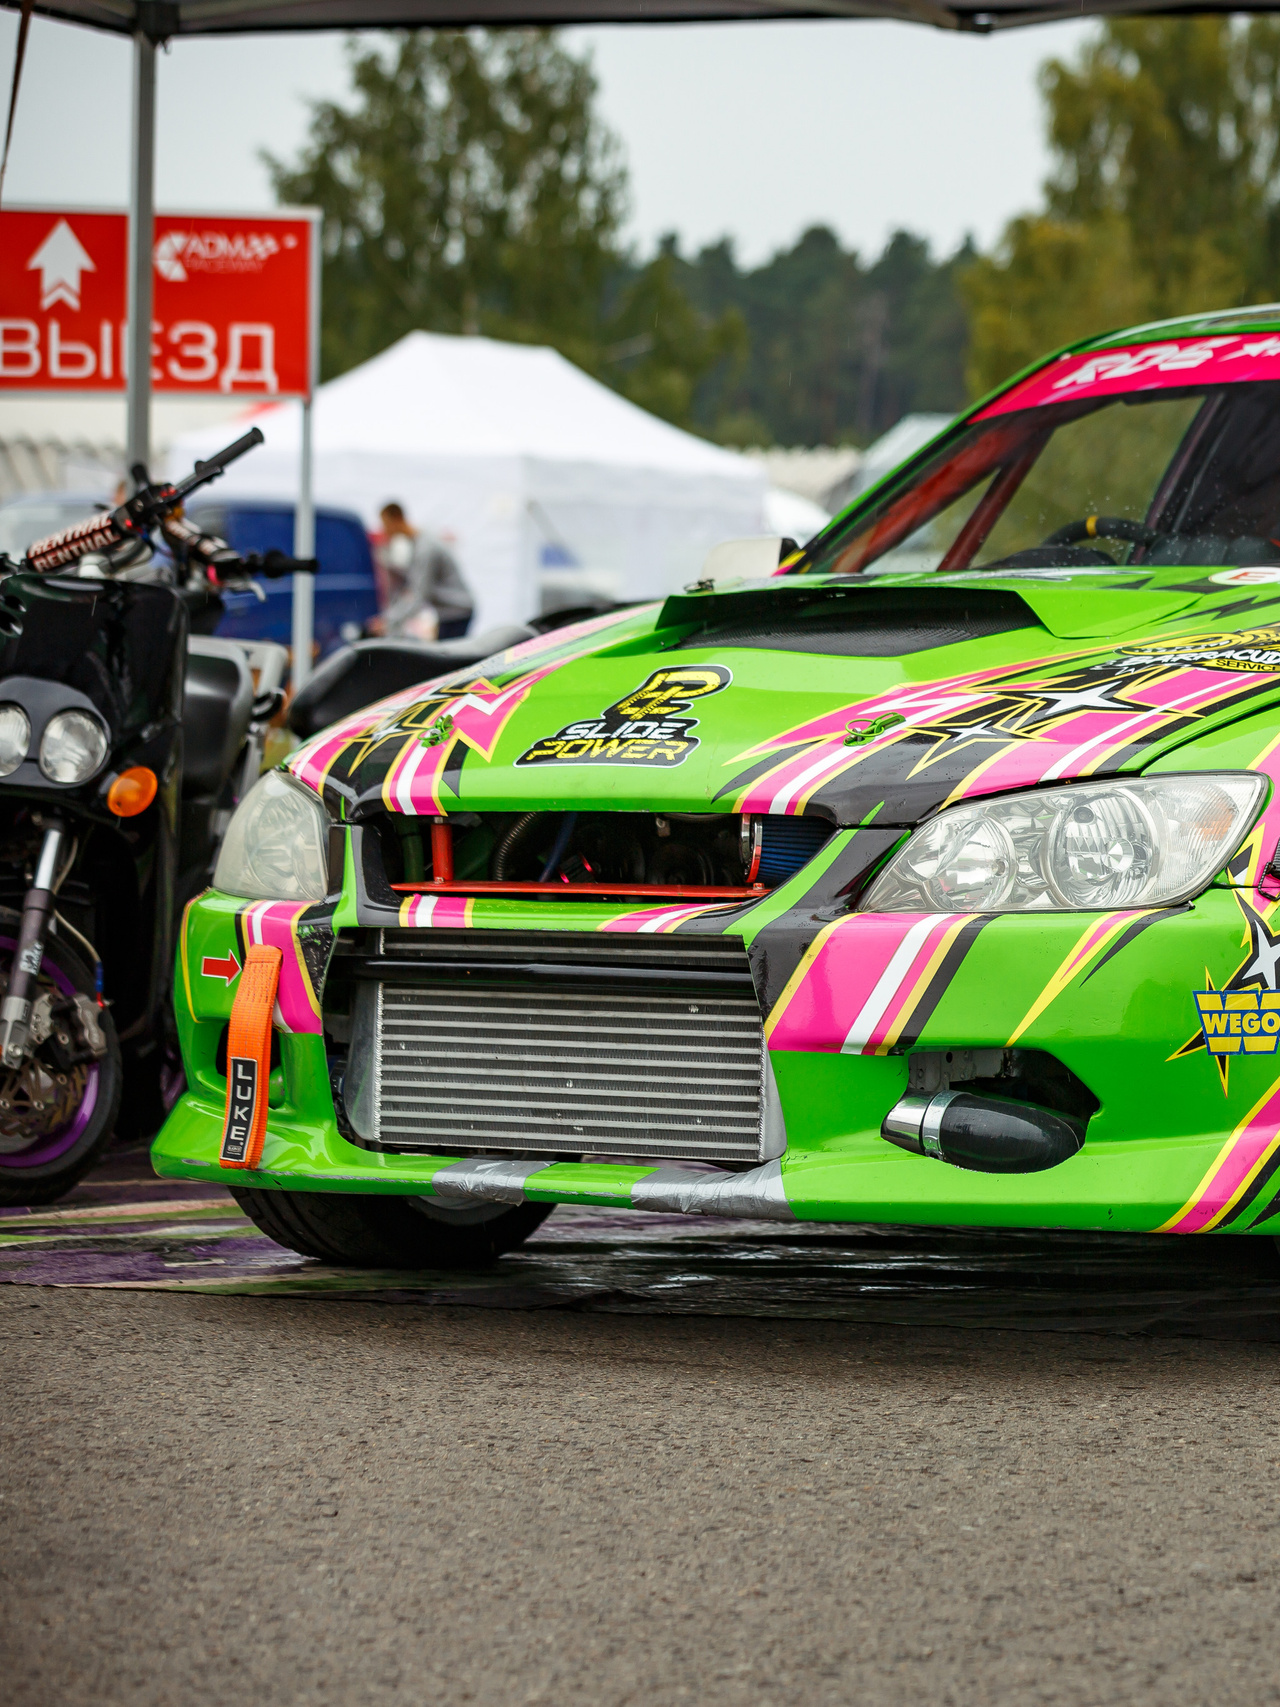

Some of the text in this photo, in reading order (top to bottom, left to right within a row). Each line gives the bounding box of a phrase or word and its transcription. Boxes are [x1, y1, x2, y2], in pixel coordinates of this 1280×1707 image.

[33, 527, 121, 573] RENTHAL
[559, 721, 687, 740] SLIDE
[526, 738, 689, 761] POWER
